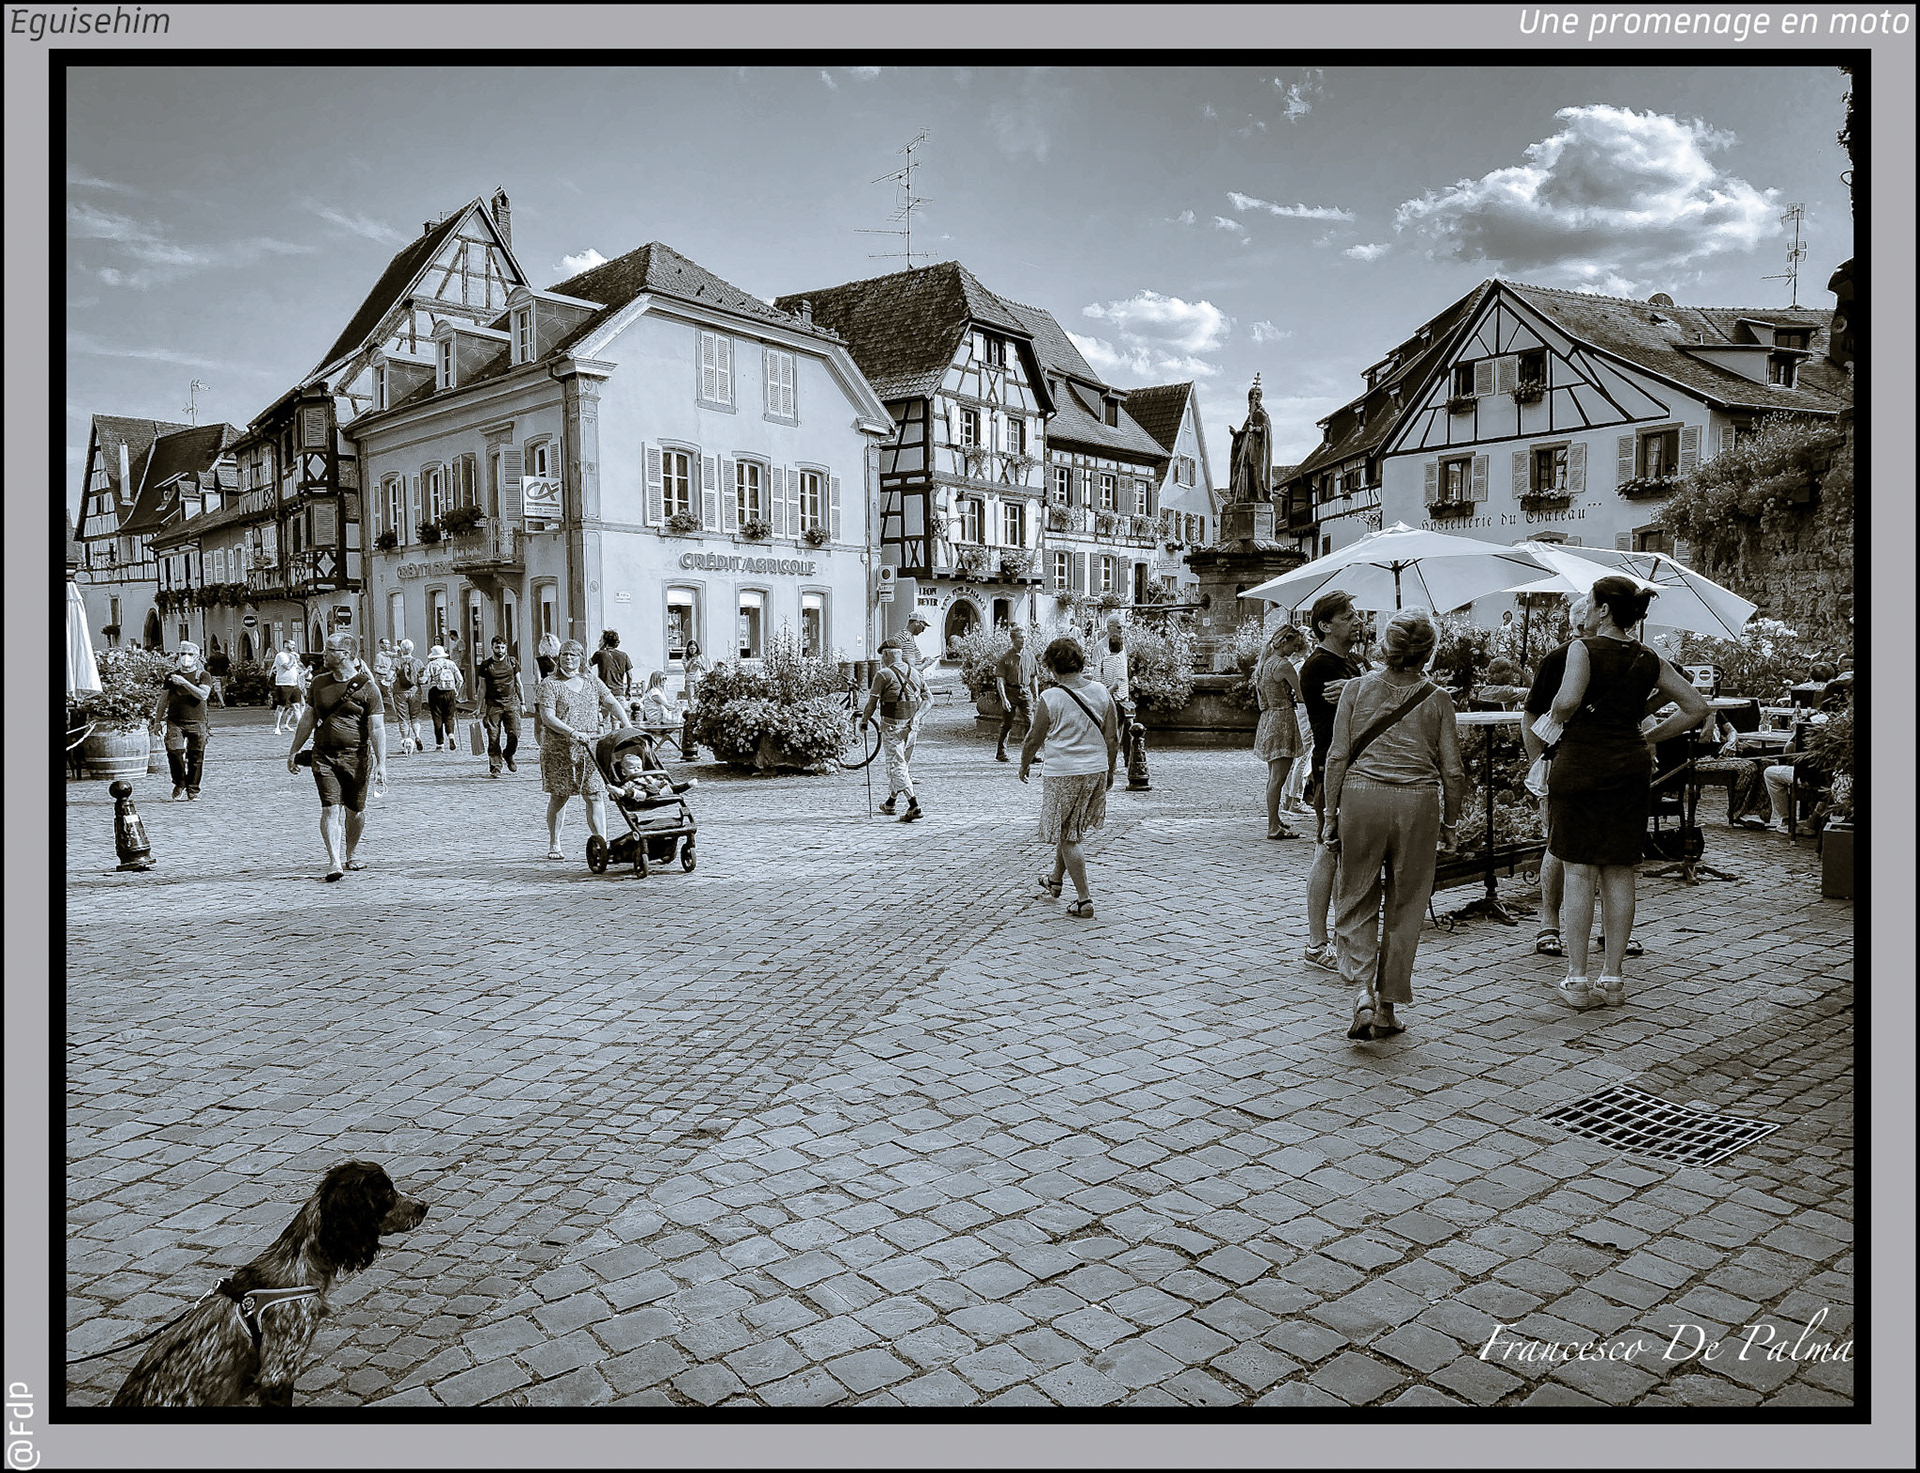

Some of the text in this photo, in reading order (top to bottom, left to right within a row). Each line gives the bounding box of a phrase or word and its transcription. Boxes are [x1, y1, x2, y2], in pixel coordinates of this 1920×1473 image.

[1501, 512, 1517, 525] du
[679, 551, 817, 577] CRÉDIT AGRICOLE
